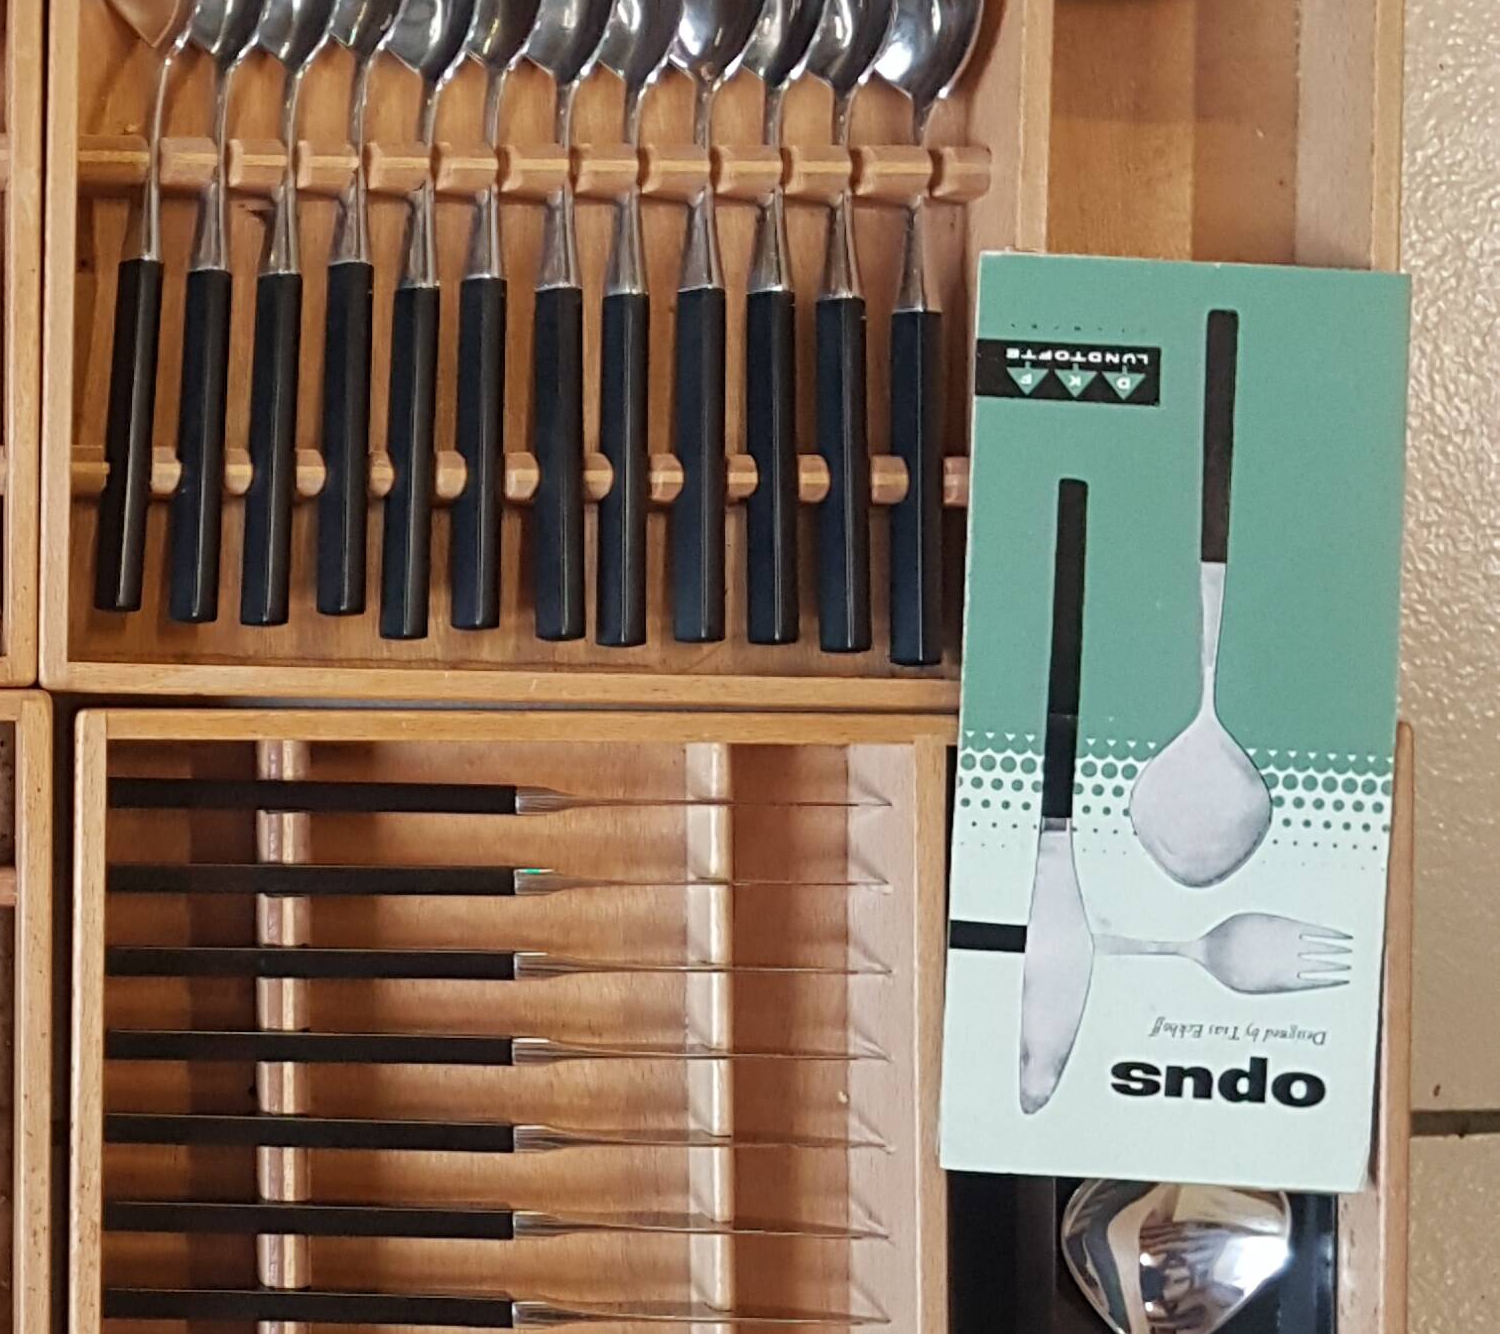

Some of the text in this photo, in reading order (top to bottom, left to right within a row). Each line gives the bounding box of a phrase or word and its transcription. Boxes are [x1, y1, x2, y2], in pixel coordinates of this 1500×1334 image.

[1005, 347, 1149, 365] LUNDTOFTE
[1068, 374, 1082, 387] K
[1116, 376, 1132, 390] D
[1148, 1016, 1327, 1045] Designed by Tias Eckhoff
[1110, 1056, 1326, 1108] opus
